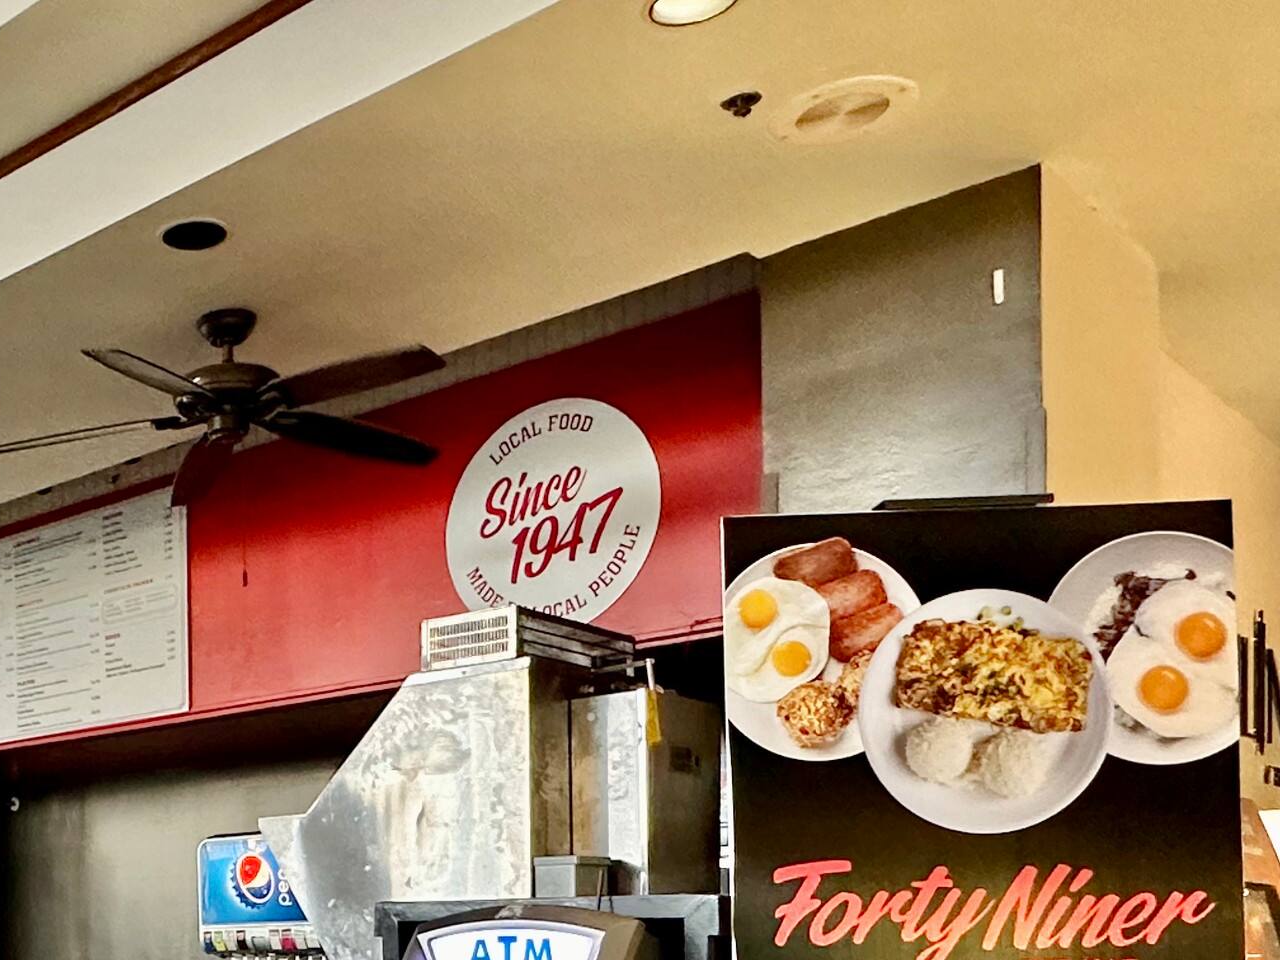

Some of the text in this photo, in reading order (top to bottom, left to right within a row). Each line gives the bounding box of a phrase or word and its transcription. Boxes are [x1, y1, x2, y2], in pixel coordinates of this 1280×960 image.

[489, 413, 594, 465] LOCAL FOOD
[480, 465, 587, 538] Since
[511, 486, 624, 585] 1947
[466, 566, 504, 607] MADE
[587, 524, 640, 597] PEOPLE
[982, 863, 1216, 951] Niner
